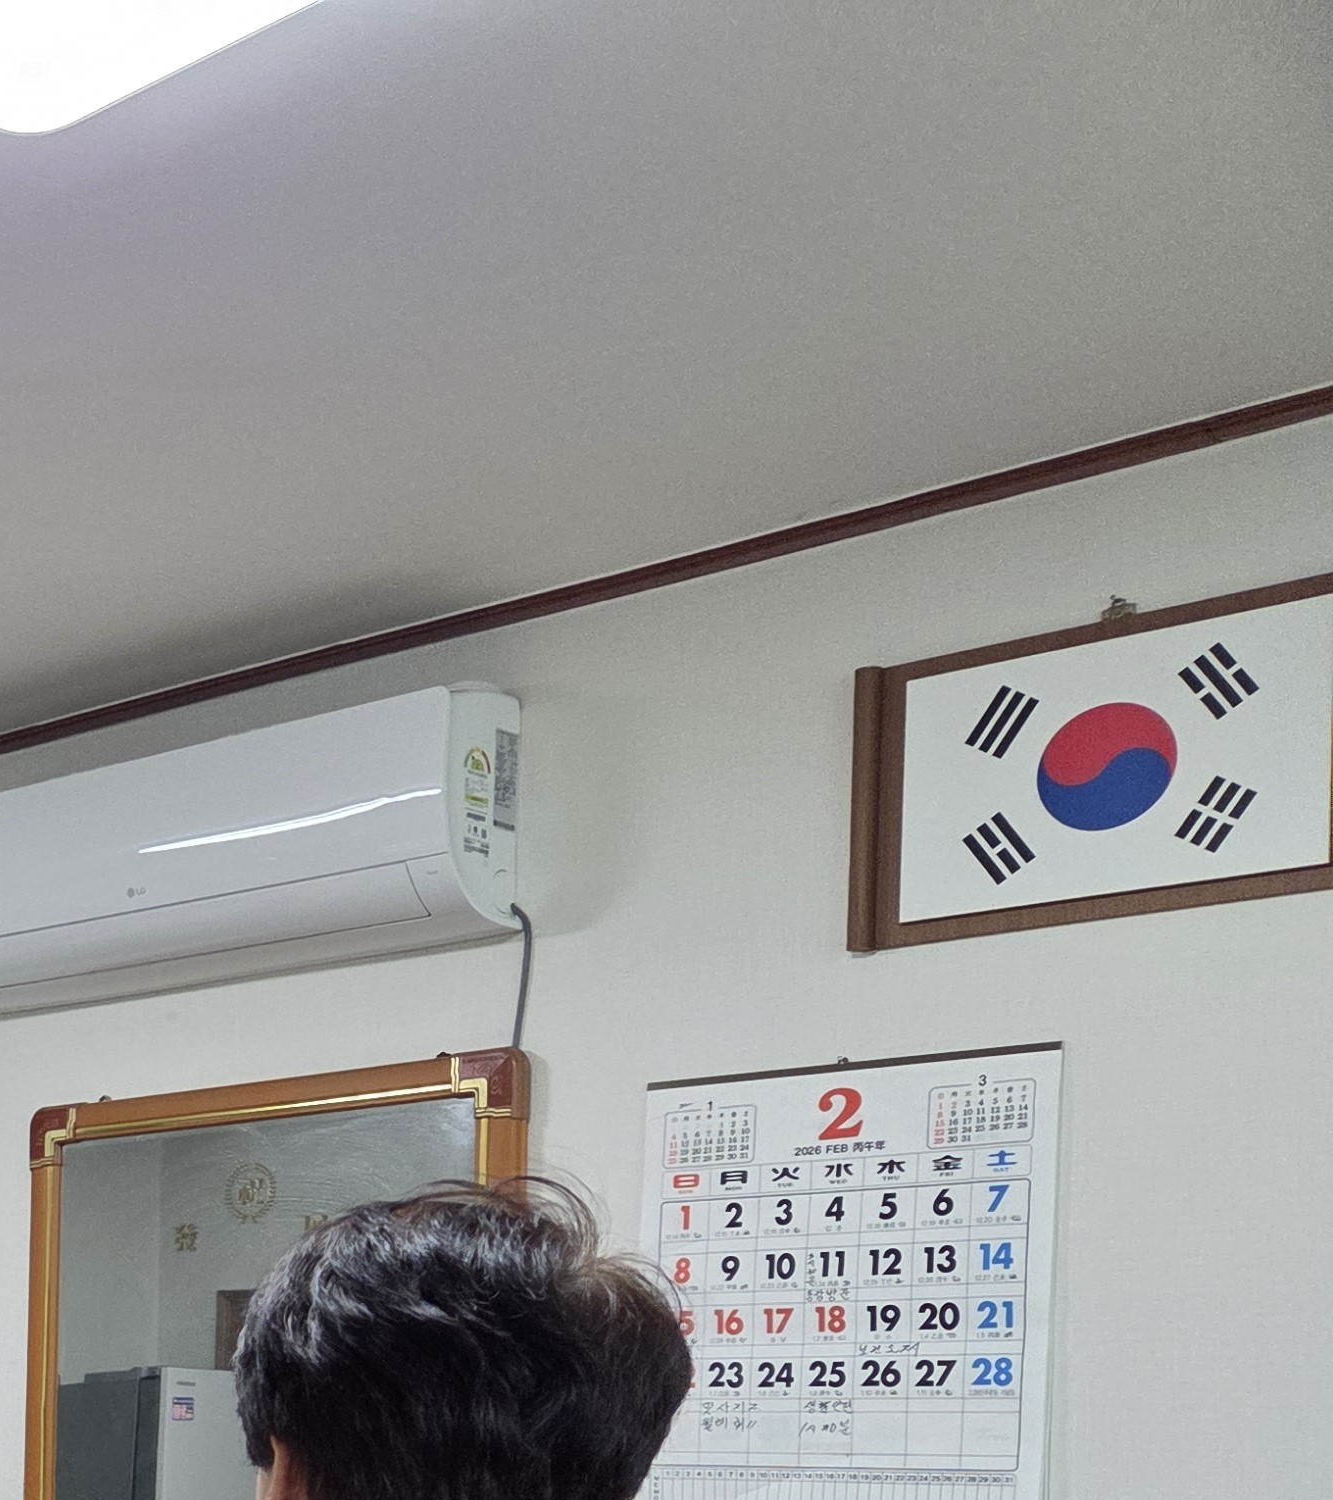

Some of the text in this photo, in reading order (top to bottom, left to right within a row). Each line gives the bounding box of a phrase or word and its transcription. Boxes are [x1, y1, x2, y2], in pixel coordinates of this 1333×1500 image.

[978, 1075, 987, 1086] 3
[819, 1088, 863, 1140] 2
[794, 1146, 821, 1156] 2026
[826, 1144, 849, 1154] FEB
[673, 1150, 1016, 1188] 日 月 火 水 木 金 土
[681, 1206, 690, 1230] 1
[725, 1203, 742, 1228] 2
[775, 1199, 792, 1225] 3
[825, 1196, 844, 1221] 4
[879, 1193, 897, 1220] 5
[933, 1189, 953, 1216] 6
[988, 1185, 1009, 1212] 7
[674, 1258, 690, 1283] 8
[722, 1256, 739, 1281] 9
[766, 1253, 795, 1279] 10
[820, 1251, 845, 1277] 11
[869, 1248, 901, 1275] 12
[924, 1245, 956, 1273] 13
[980, 1243, 1013, 1270] 14
[715, 1310, 743, 1335] 16
[764, 1308, 794, 1333] 17
[815, 1306, 845, 1333] 18
[867, 1305, 900, 1331] 19
[919, 1302, 959, 1330] 20
[978, 1301, 1013, 1328] 21
[709, 1357, 1012, 1388] 23 24 25 26 27 28
